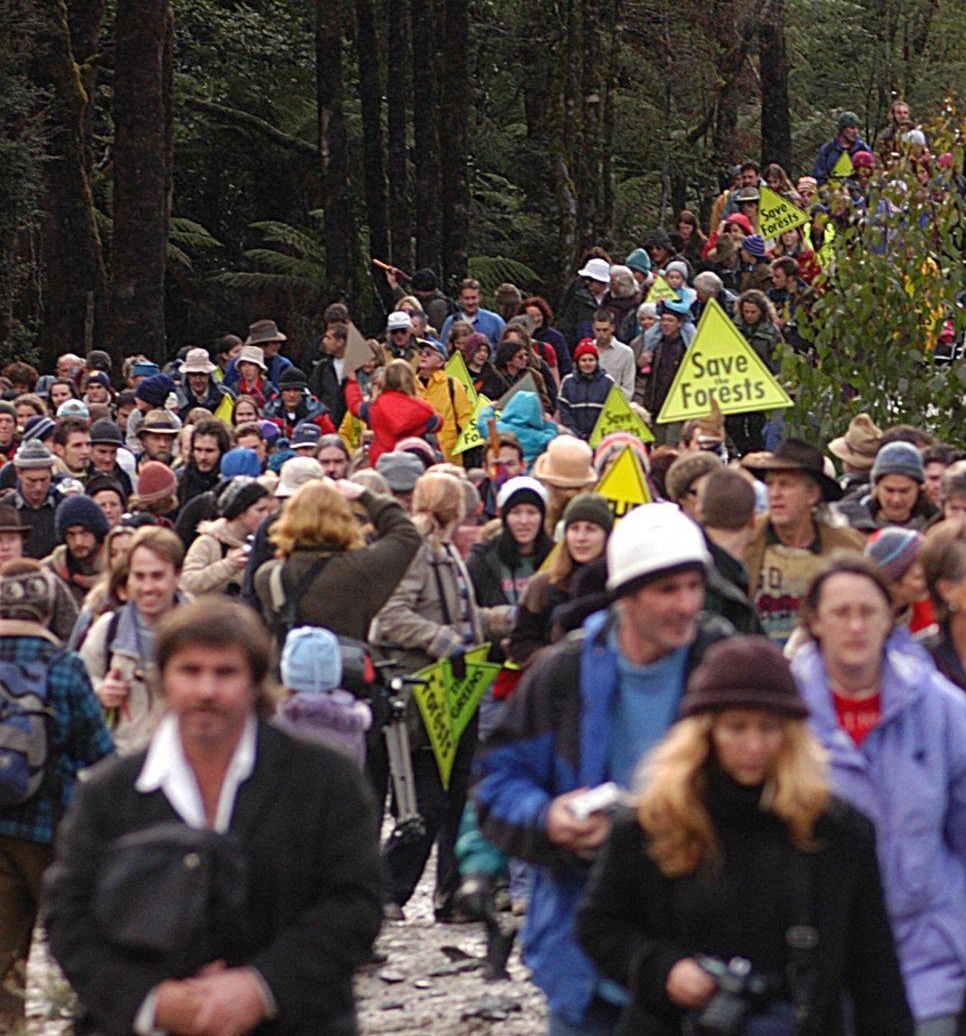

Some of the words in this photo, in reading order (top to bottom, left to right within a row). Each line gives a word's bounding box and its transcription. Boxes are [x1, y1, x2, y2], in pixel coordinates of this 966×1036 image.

[761, 204, 788, 222] Save
[761, 213, 799, 236] Forests
[691, 352, 748, 379] Save
[681, 378, 766, 409] Forests
[450, 670, 484, 720] GREENS
